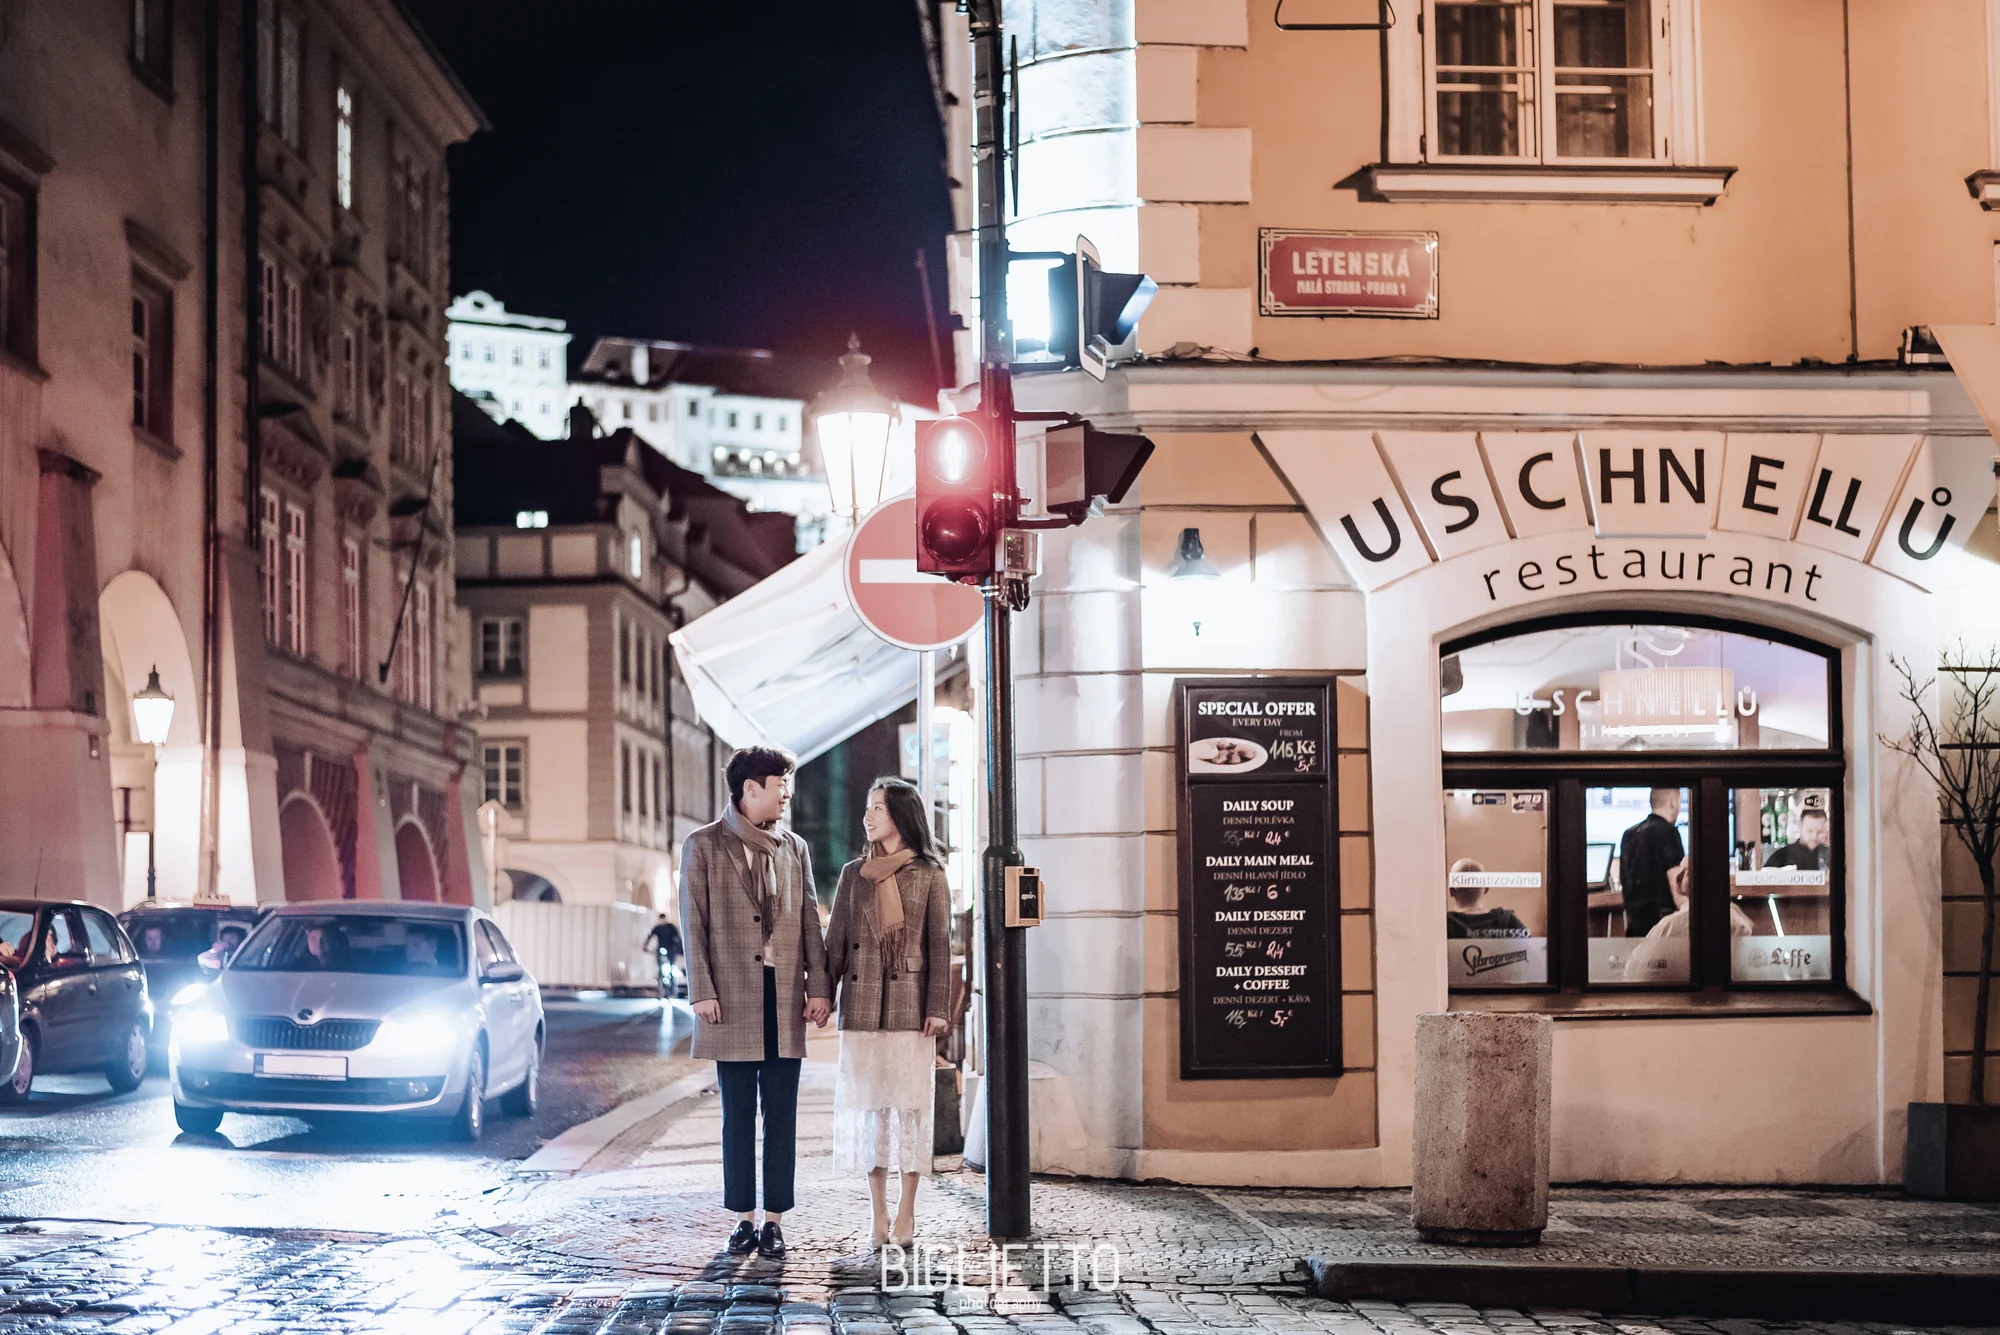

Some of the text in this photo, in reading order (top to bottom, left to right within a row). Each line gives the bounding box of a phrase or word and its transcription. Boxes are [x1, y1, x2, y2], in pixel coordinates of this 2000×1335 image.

[1292, 248, 1411, 278] LETENSKÁ
[1297, 278, 1407, 297] MALÁ STRANA PRAHA 1
[1483, 543, 1824, 602] restaurant
[1198, 702, 1317, 716] SPECIAL OFFER
[1232, 718, 1282, 727] EVERY DAY
[1279, 729, 1303, 737] FROM
[1297, 740, 1317, 755] Kč
[1223, 800, 1294, 812] DAILY SOUP
[1223, 815, 1295, 825] DENNÍ POLÉVKA
[1206, 855, 1313, 867] DAILY MAIN MEAL
[1213, 869, 1306, 880] DENNÍ HLAVNÍ JÍDLO
[1452, 874, 1539, 886] Klimatizováno
[1267, 884, 1278, 900] 6
[1215, 910, 1306, 922] DAILY DESSERT
[1227, 926, 1294, 935] DENNÍ DEZERT
[1462, 945, 1529, 976] Staropramen
[1216, 965, 1307, 977] DAILY DESSERT
[1243, 979, 1290, 991] COFFEE
[1213, 995, 1243, 1005] DENNÍ
[1245, 996, 1279, 1004] DEZERT
[1288, 994, 1311, 1003] KÁVA
